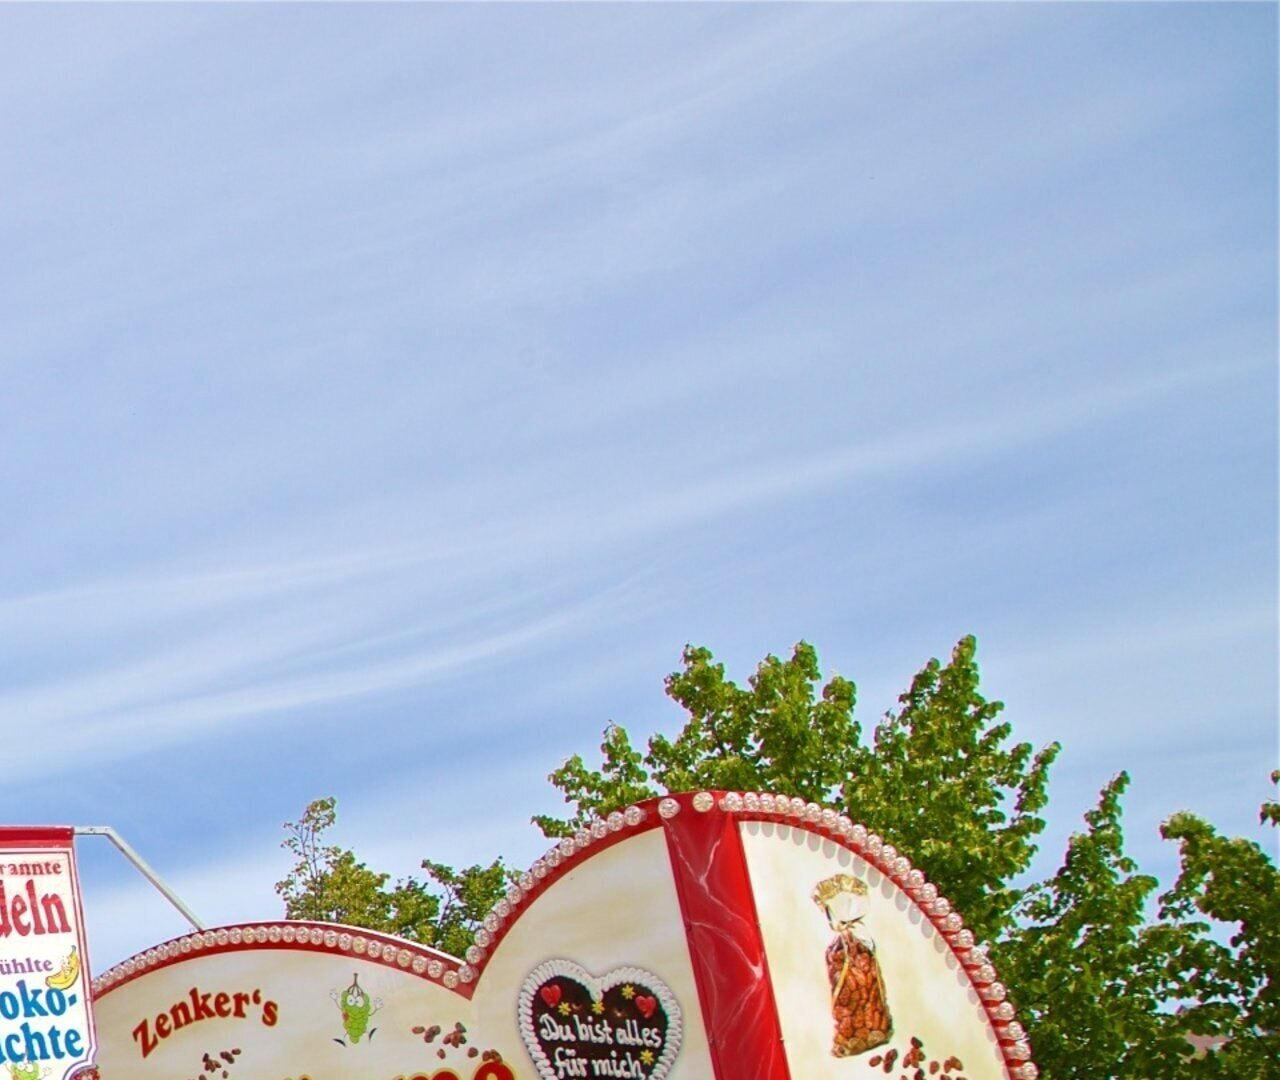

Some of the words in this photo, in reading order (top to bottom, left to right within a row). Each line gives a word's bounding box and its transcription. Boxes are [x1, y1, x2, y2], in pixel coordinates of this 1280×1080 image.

[539, 1013, 576, 1042] Du
[573, 1014, 614, 1045] bist
[616, 1019, 662, 1048] alles
[554, 1046, 588, 1079] für
[591, 1050, 646, 1080] mich
